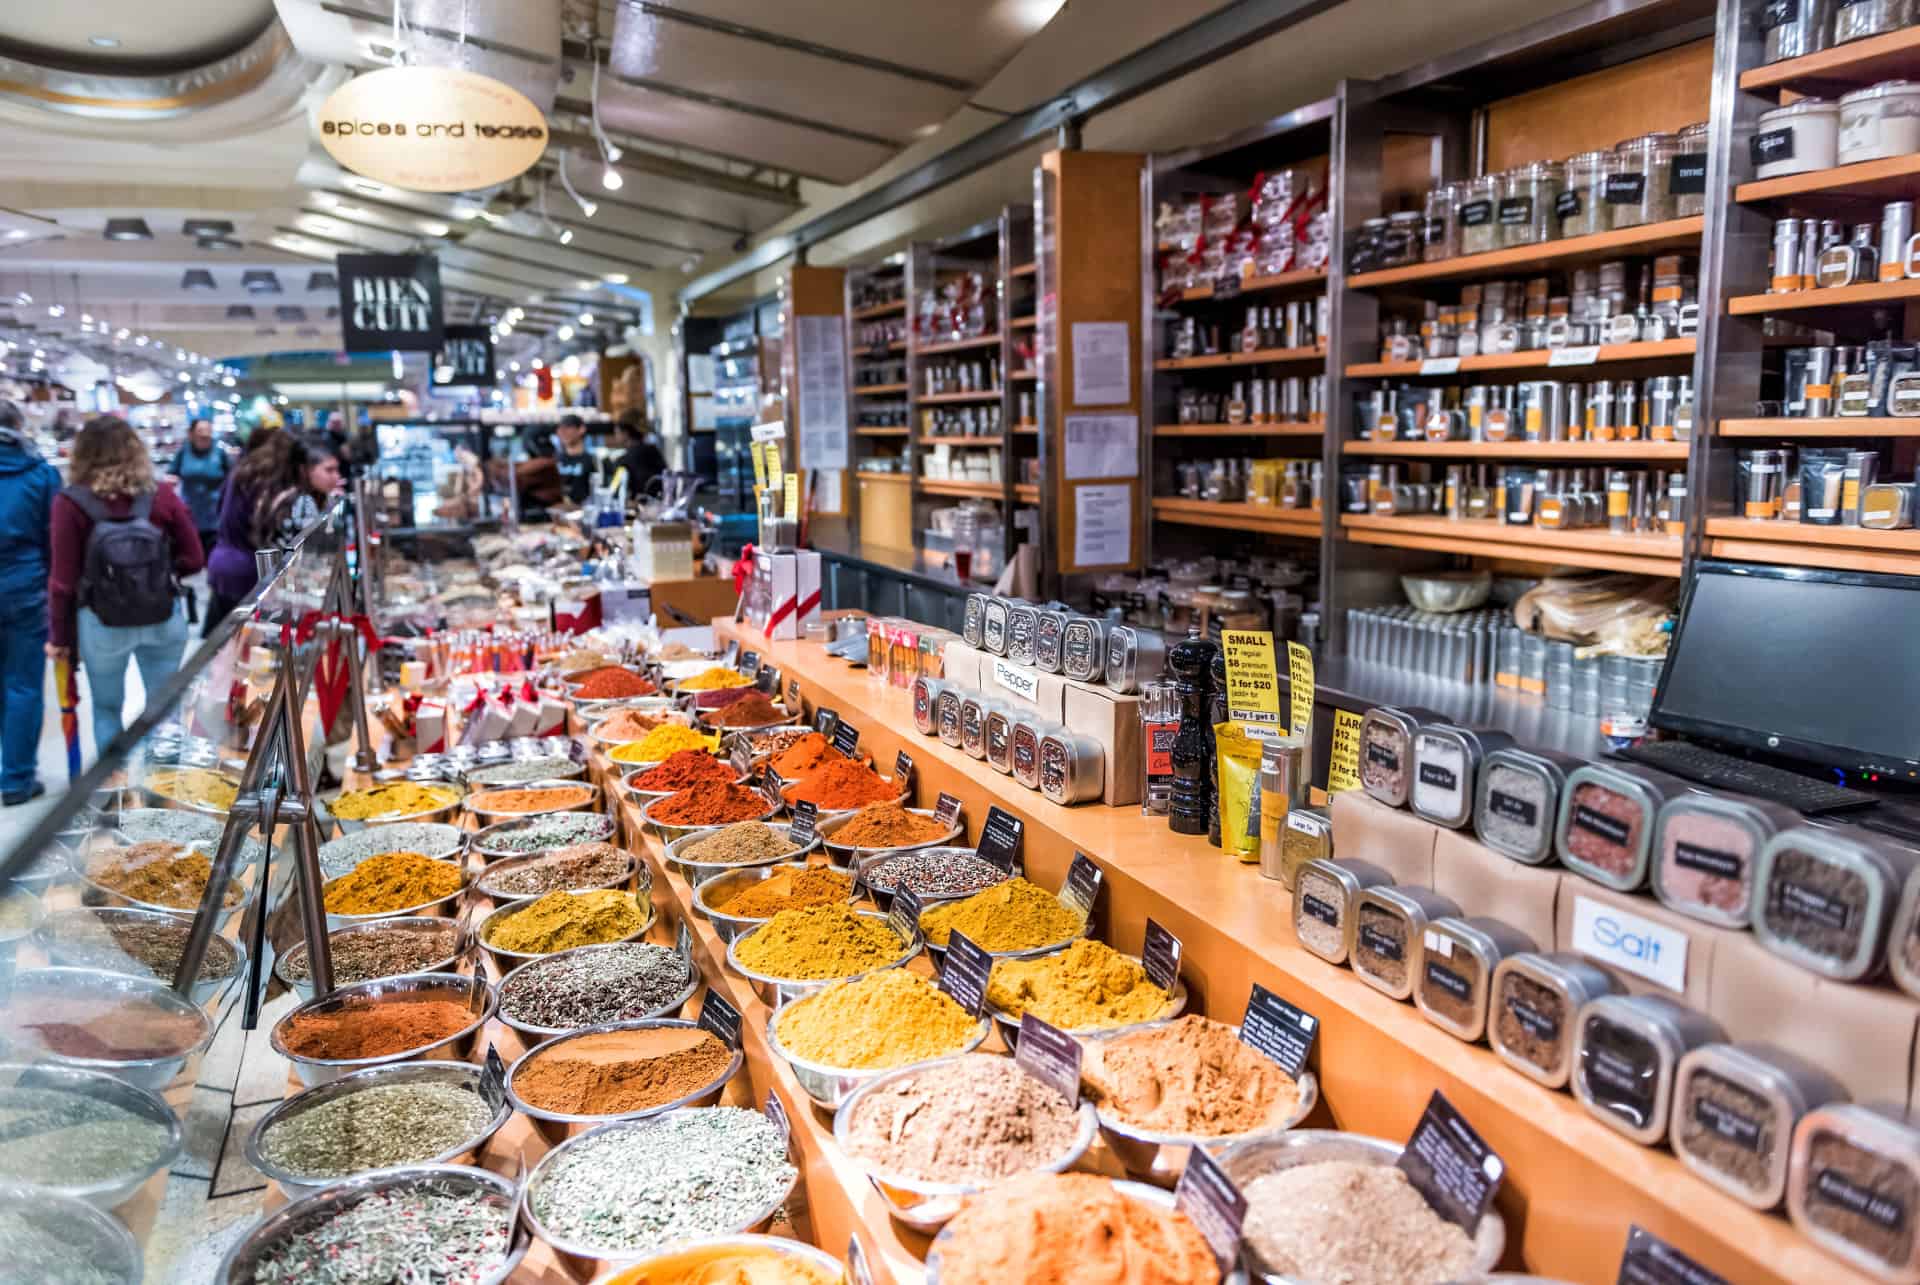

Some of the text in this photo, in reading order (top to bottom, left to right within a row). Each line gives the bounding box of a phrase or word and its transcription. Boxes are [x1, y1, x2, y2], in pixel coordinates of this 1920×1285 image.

[322, 120, 543, 139] spices and tease
[353, 277, 430, 303] BIEN
[353, 300, 432, 331] CUIT
[1228, 634, 1267, 646] SMALL
[1227, 647, 1238, 656] $7
[1228, 659, 1239, 668] $8
[997, 663, 1033, 693] Pepper
[1231, 679, 1271, 690] 3 for $20
[1233, 711, 1247, 720] Buy
[1340, 716, 1360, 729] LAR
[1339, 764, 1350, 775] for
[1593, 915, 1661, 963] Salt
